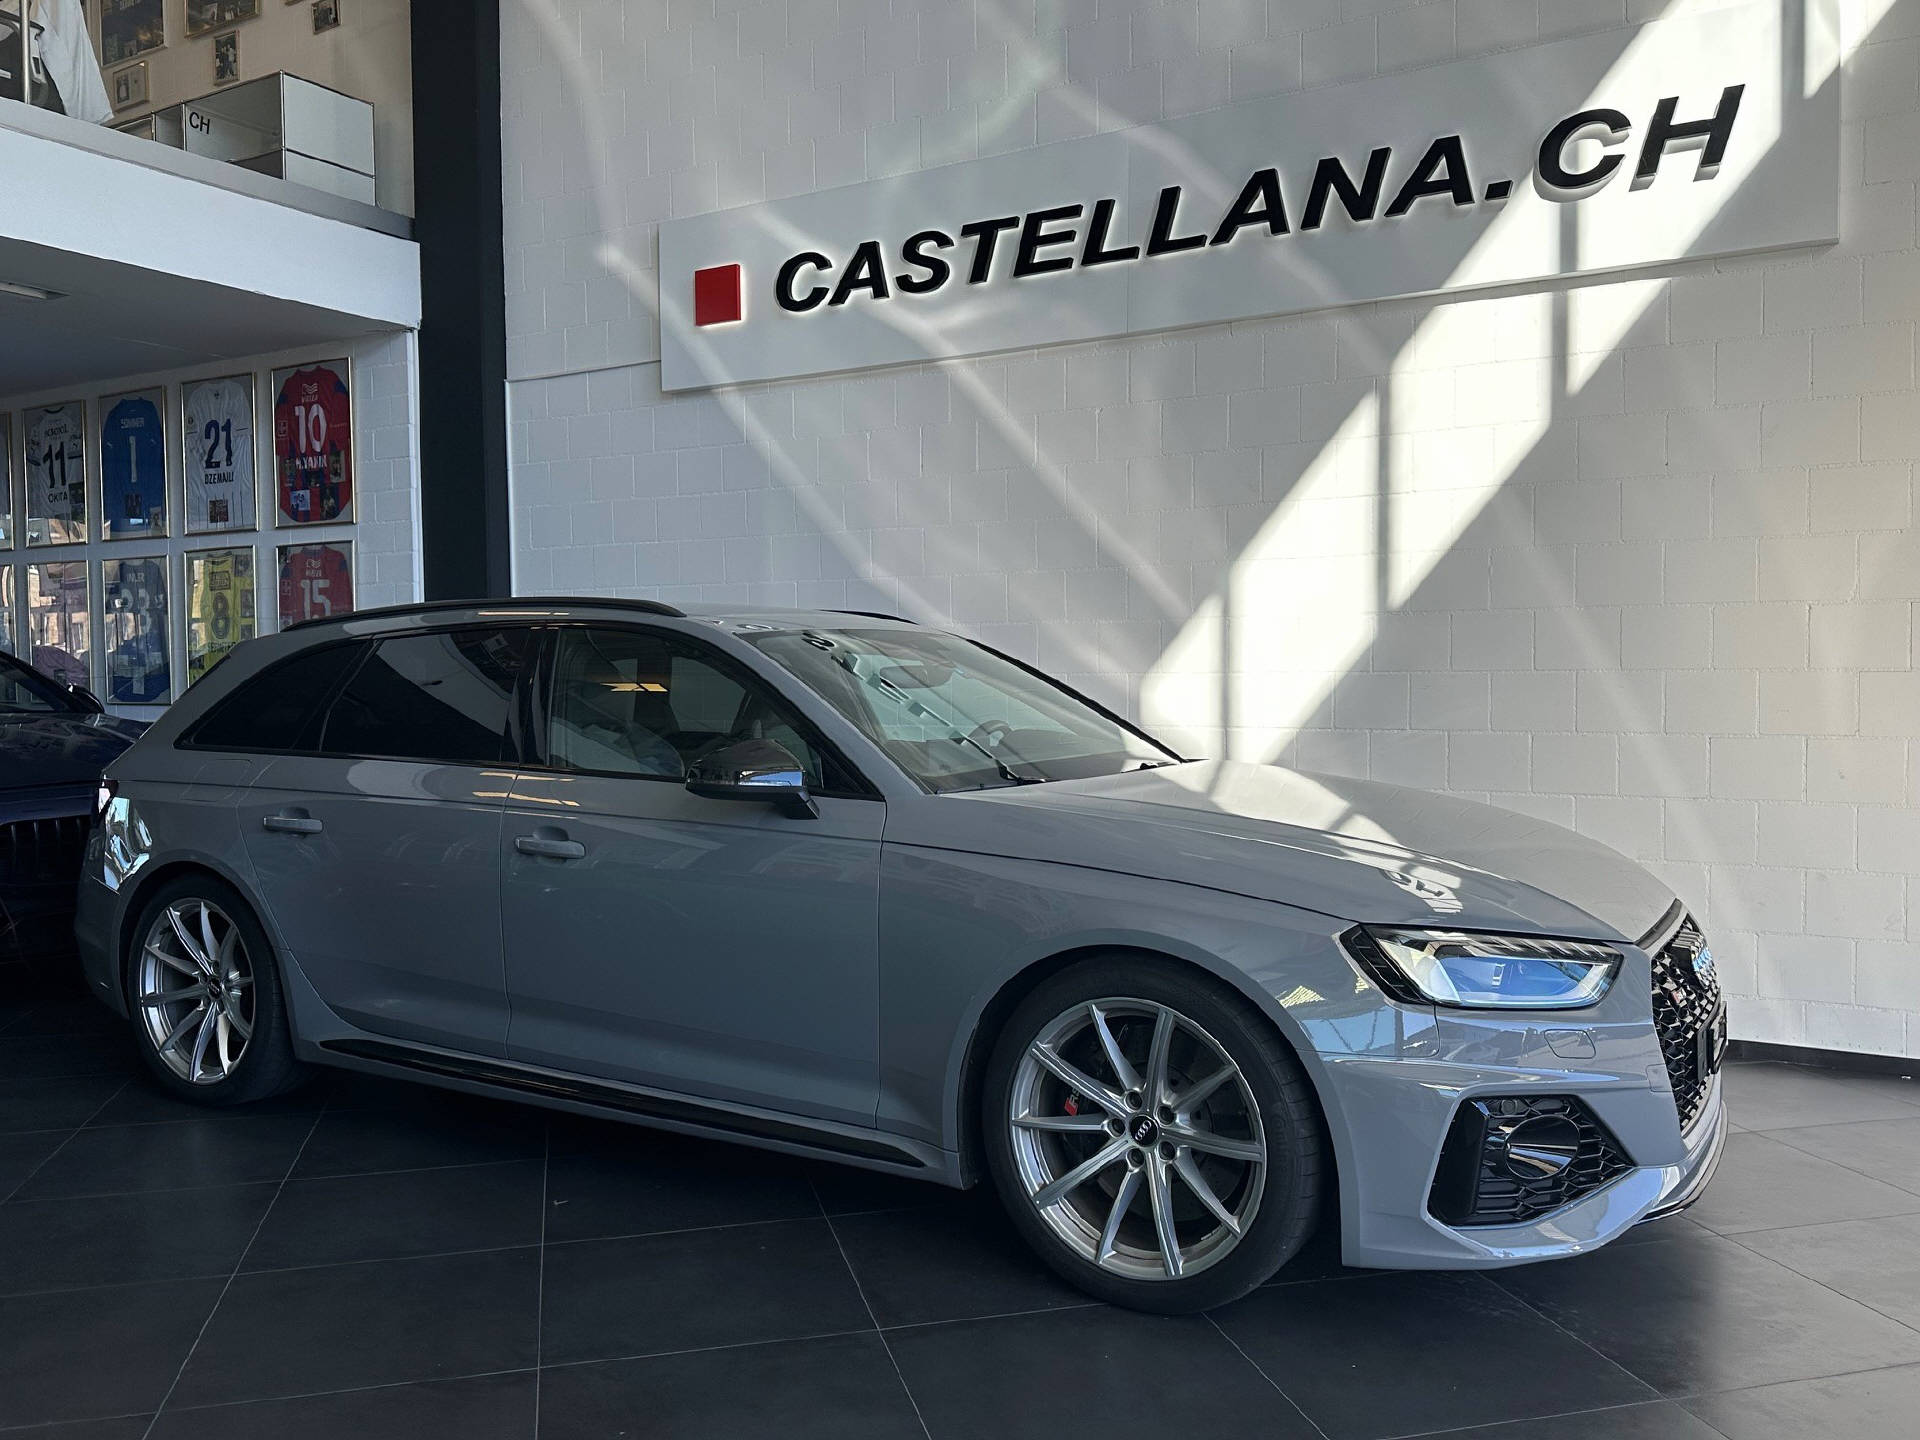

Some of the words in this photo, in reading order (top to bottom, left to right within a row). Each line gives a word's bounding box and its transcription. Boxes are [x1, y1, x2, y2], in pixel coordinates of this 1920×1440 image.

[189, 111, 210, 135] CH
[773, 83, 1746, 314] CASTELLANA.CH
[204, 418, 233, 469] 21
[294, 403, 327, 454] 10
[43, 441, 66, 489] 11
[129, 435, 138, 483] 1
[204, 472, 234, 485] DZEMAILI
[211, 591, 231, 640] 8
[300, 579, 331, 620] 15
